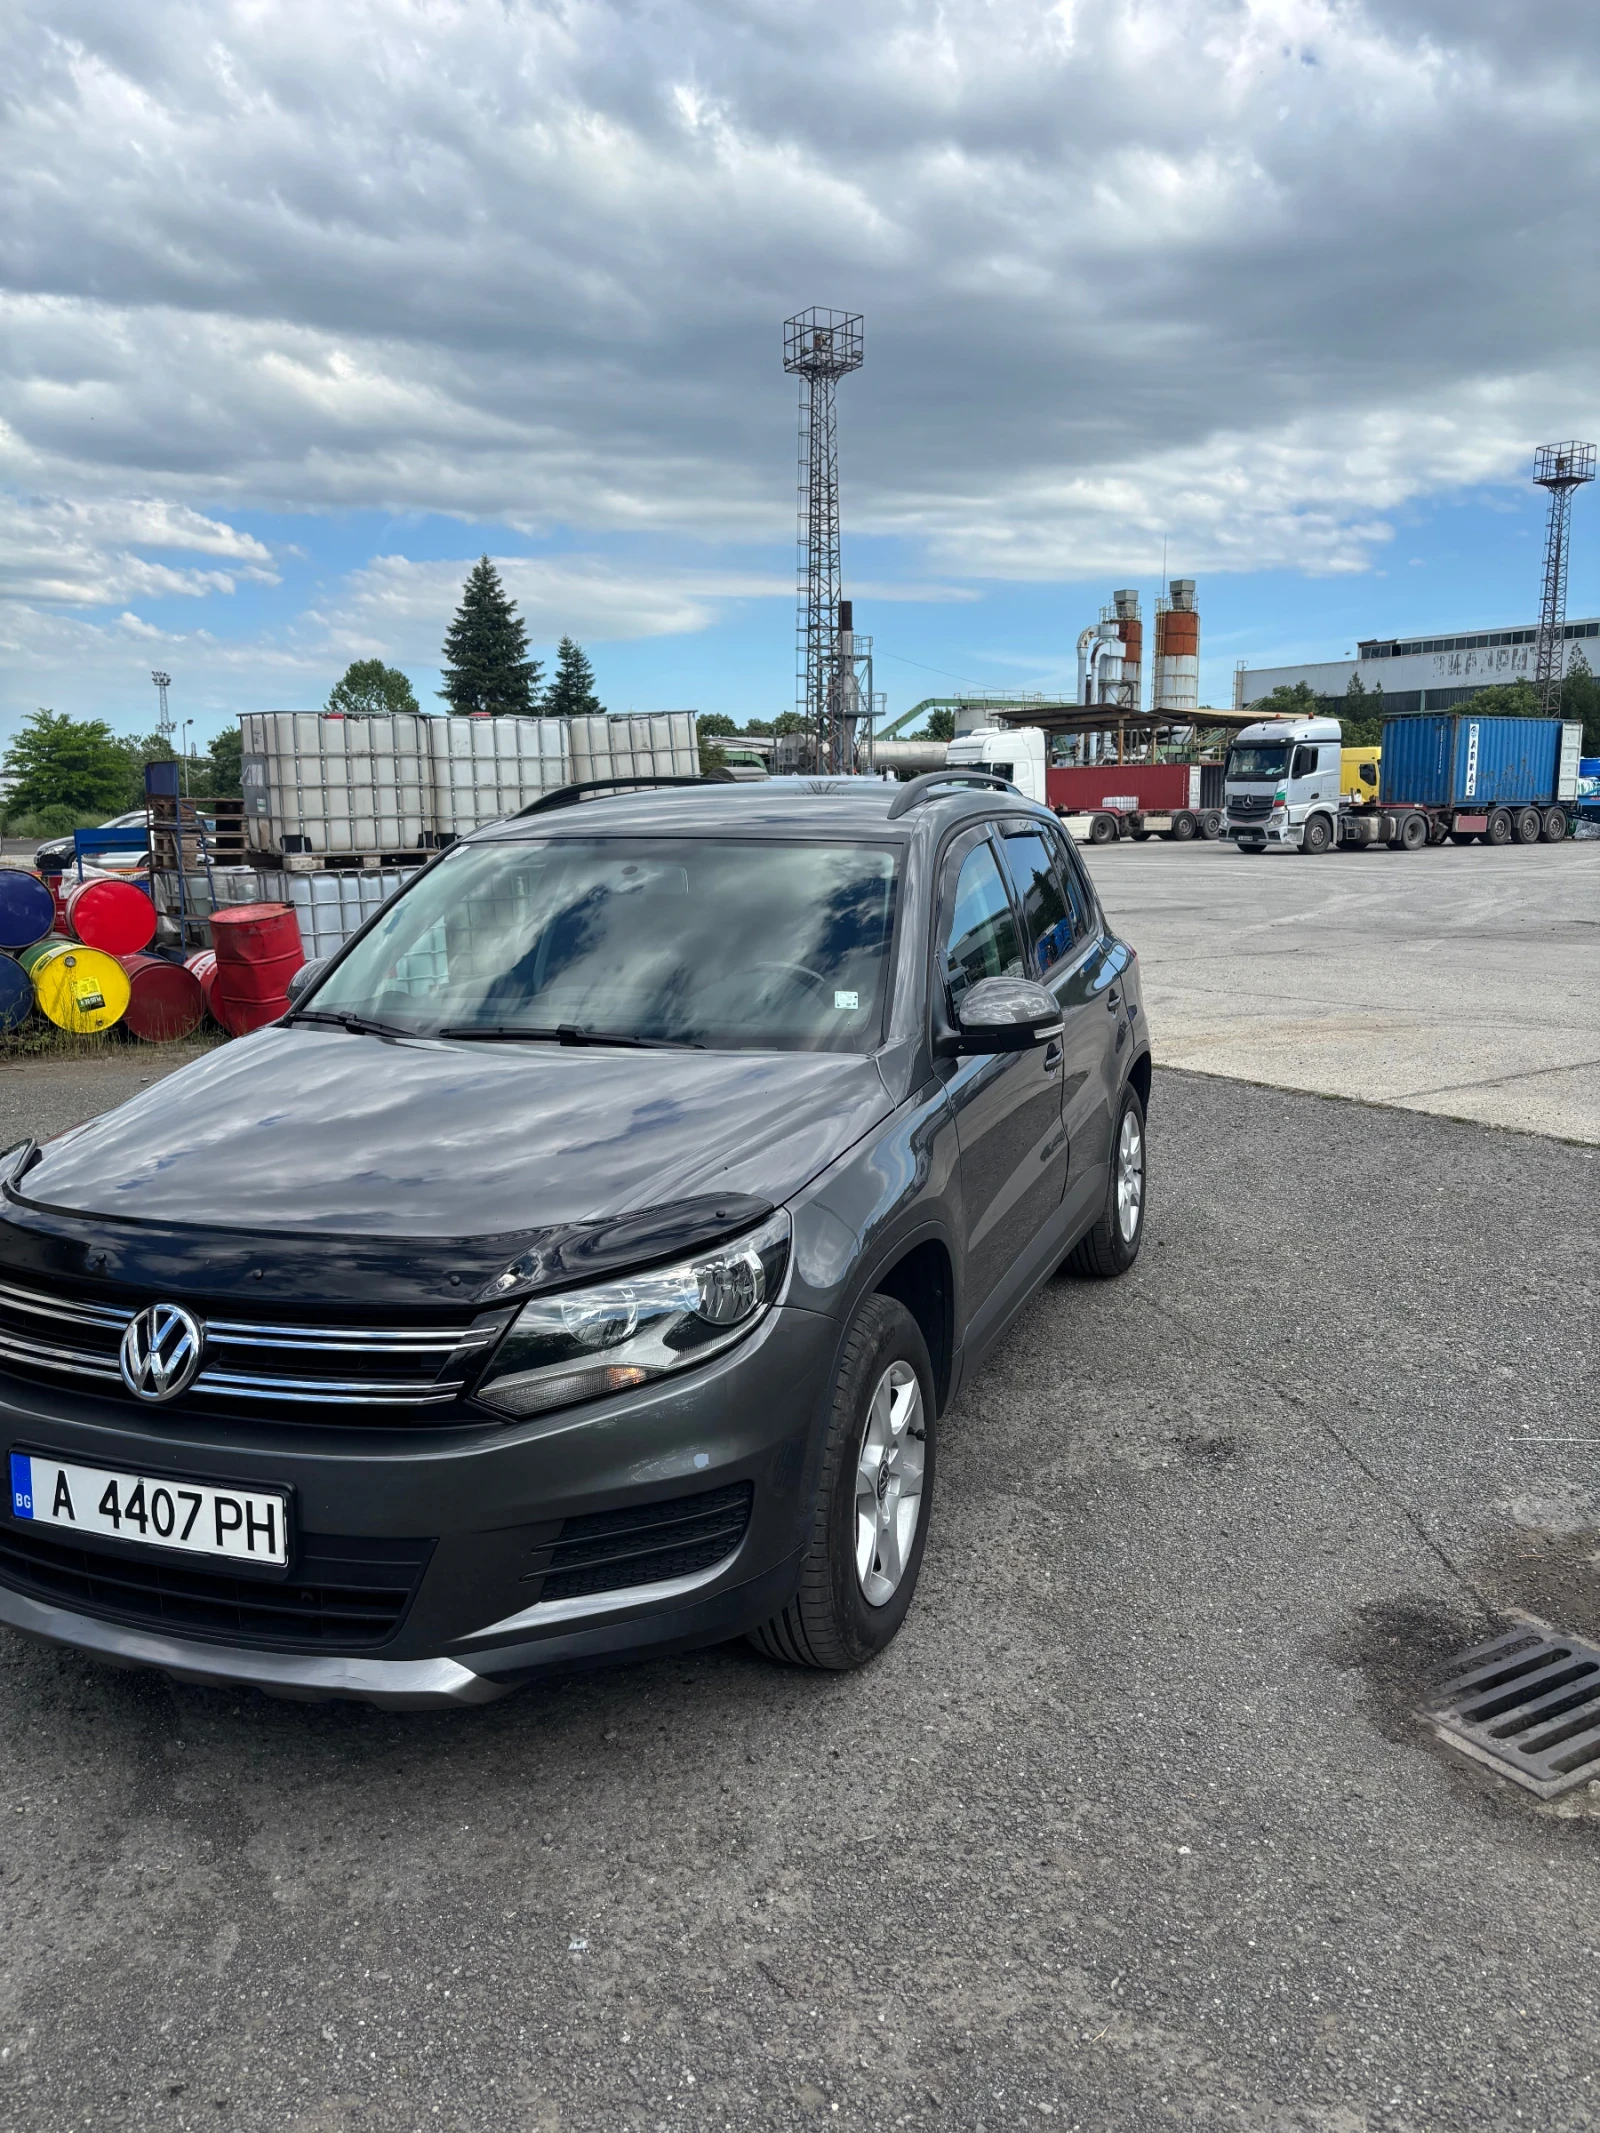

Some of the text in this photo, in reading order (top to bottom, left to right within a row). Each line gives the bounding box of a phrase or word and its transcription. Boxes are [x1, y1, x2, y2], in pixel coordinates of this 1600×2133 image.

[1468, 739, 1476, 794] ARKAS
[120, 1304, 199, 1401] VW
[15, 1492, 31, 1509] BG
[52, 1469, 276, 1554] A 4407 PH
